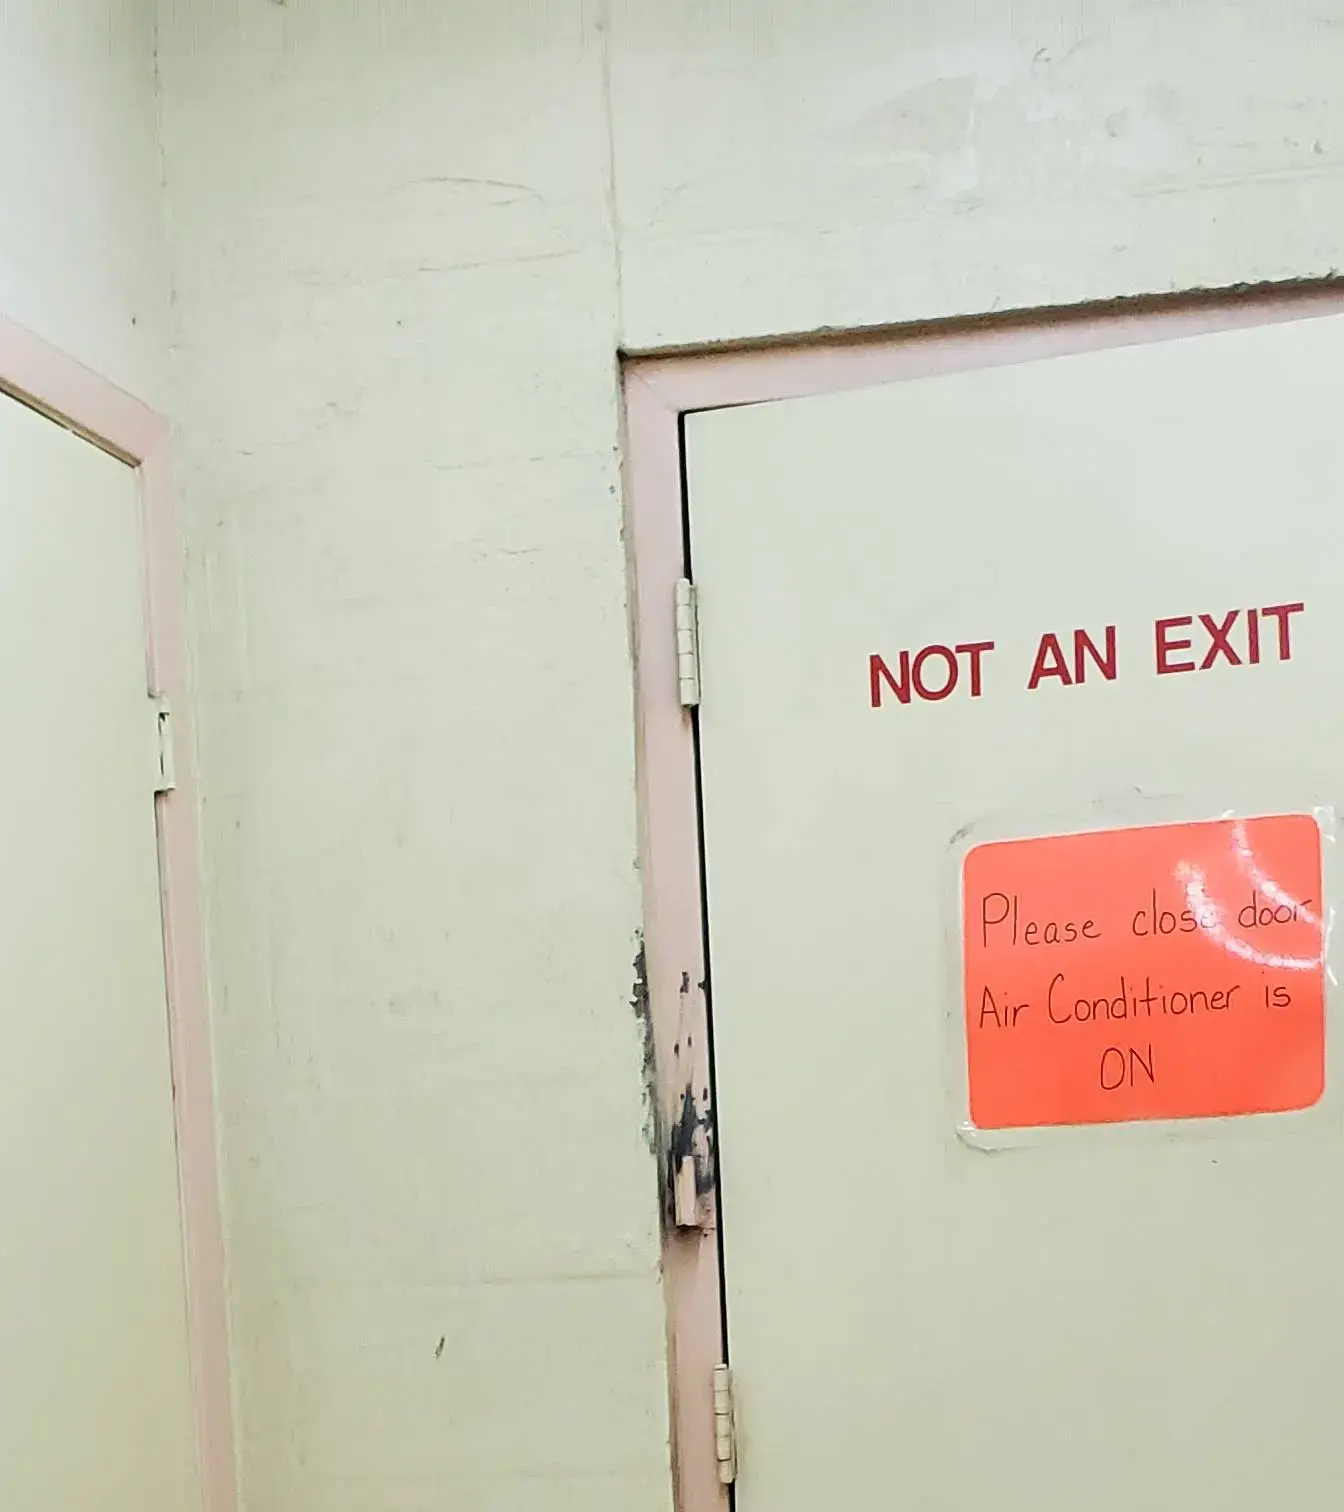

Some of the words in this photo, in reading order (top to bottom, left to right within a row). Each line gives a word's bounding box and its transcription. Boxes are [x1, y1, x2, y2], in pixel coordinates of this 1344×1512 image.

[869, 643, 995, 707] NOT
[1028, 626, 1117, 689] AN
[1155, 603, 1305, 675] EXIT
[982, 892, 1101, 947] Please
[1131, 888, 1219, 937] close
[1238, 891, 1313, 930] door
[979, 985, 1030, 1030] Air
[1048, 973, 1240, 1025] Conditioner
[1263, 972, 1292, 1009] is
[1100, 1045, 1156, 1091] ON
